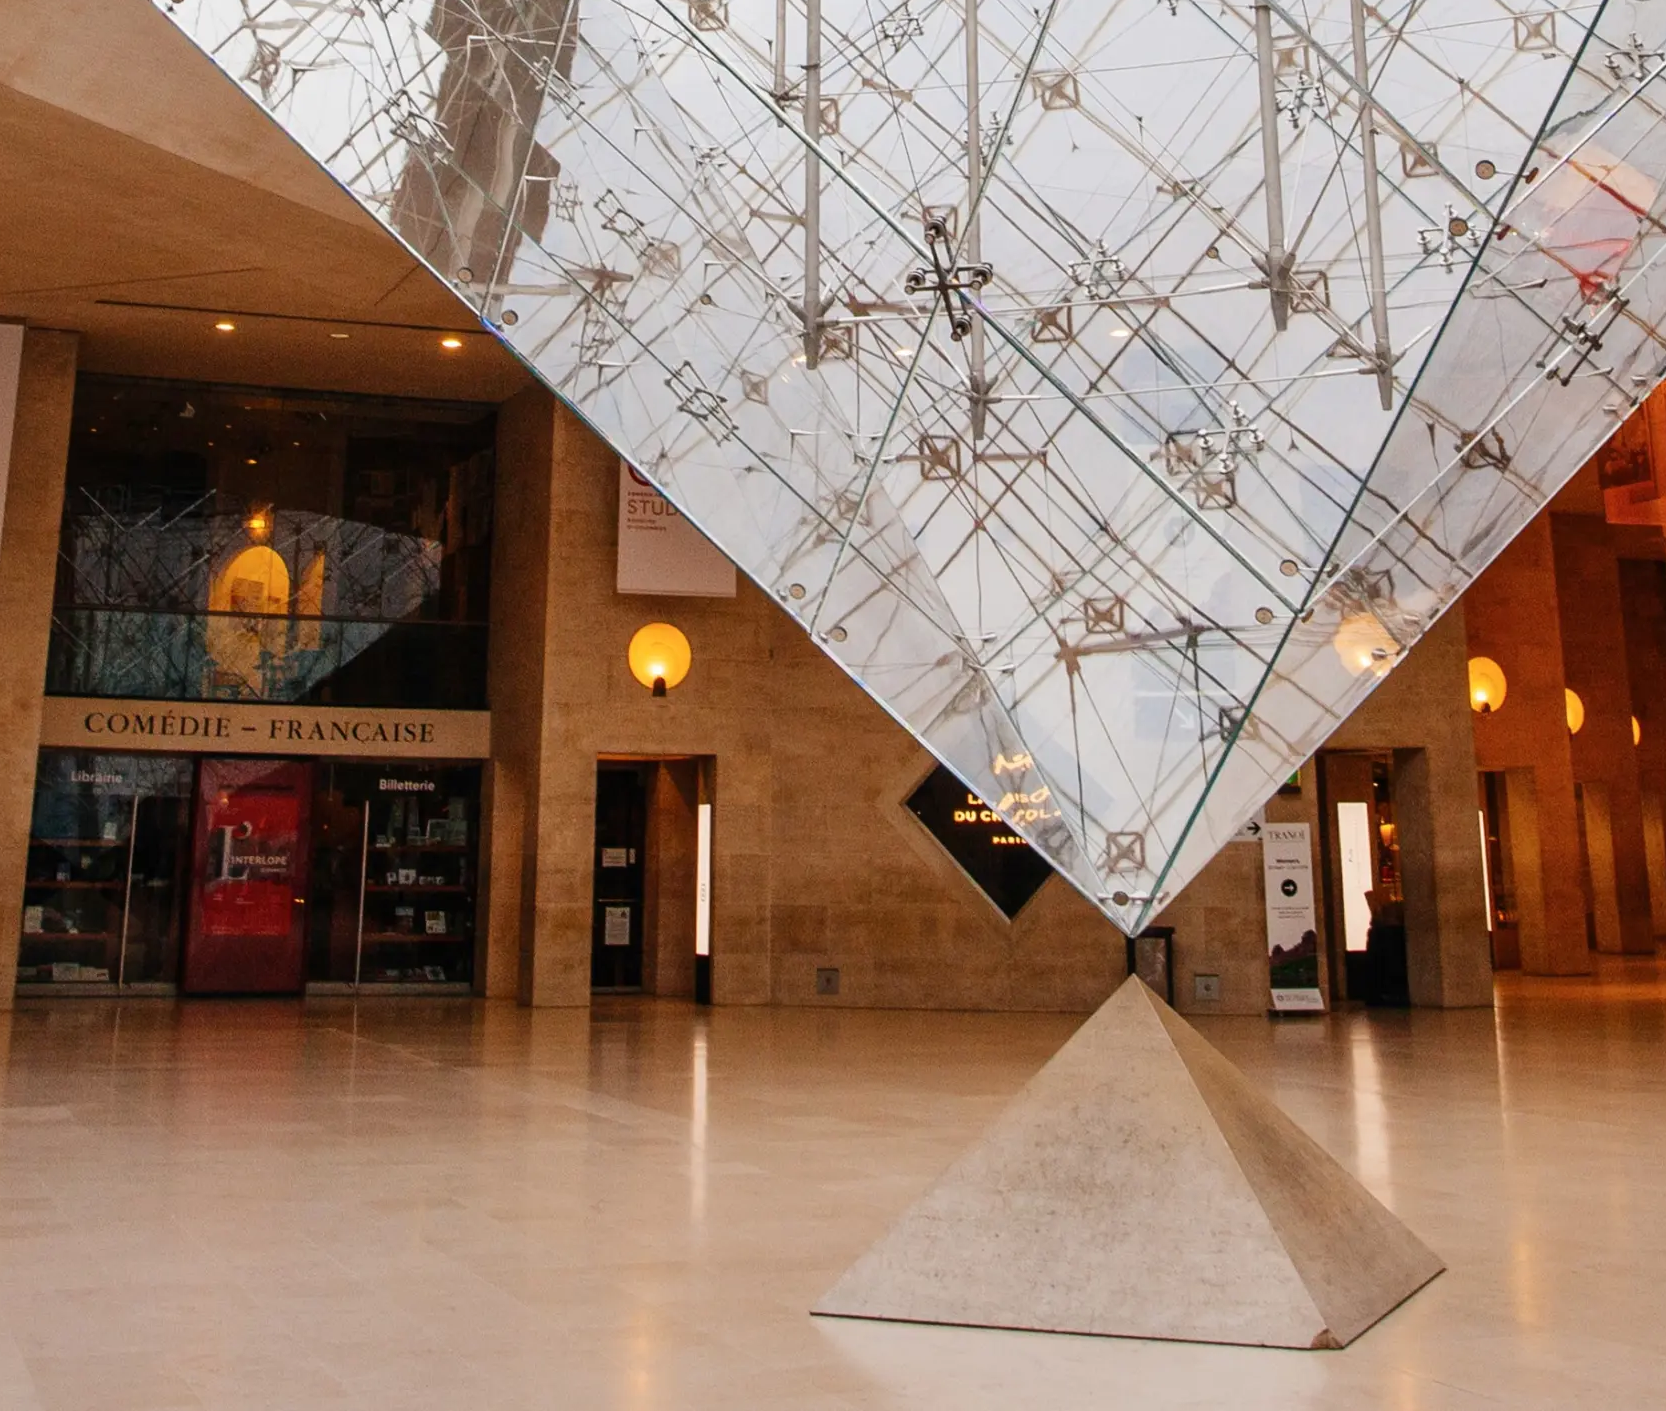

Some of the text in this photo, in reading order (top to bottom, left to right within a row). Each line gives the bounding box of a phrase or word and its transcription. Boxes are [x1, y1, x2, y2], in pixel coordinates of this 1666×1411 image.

[83, 709, 231, 739] COMÉDIE
[269, 718, 436, 744] FRANÇAISE
[378, 777, 436, 792] Billetterie
[953, 810, 977, 823] DU
